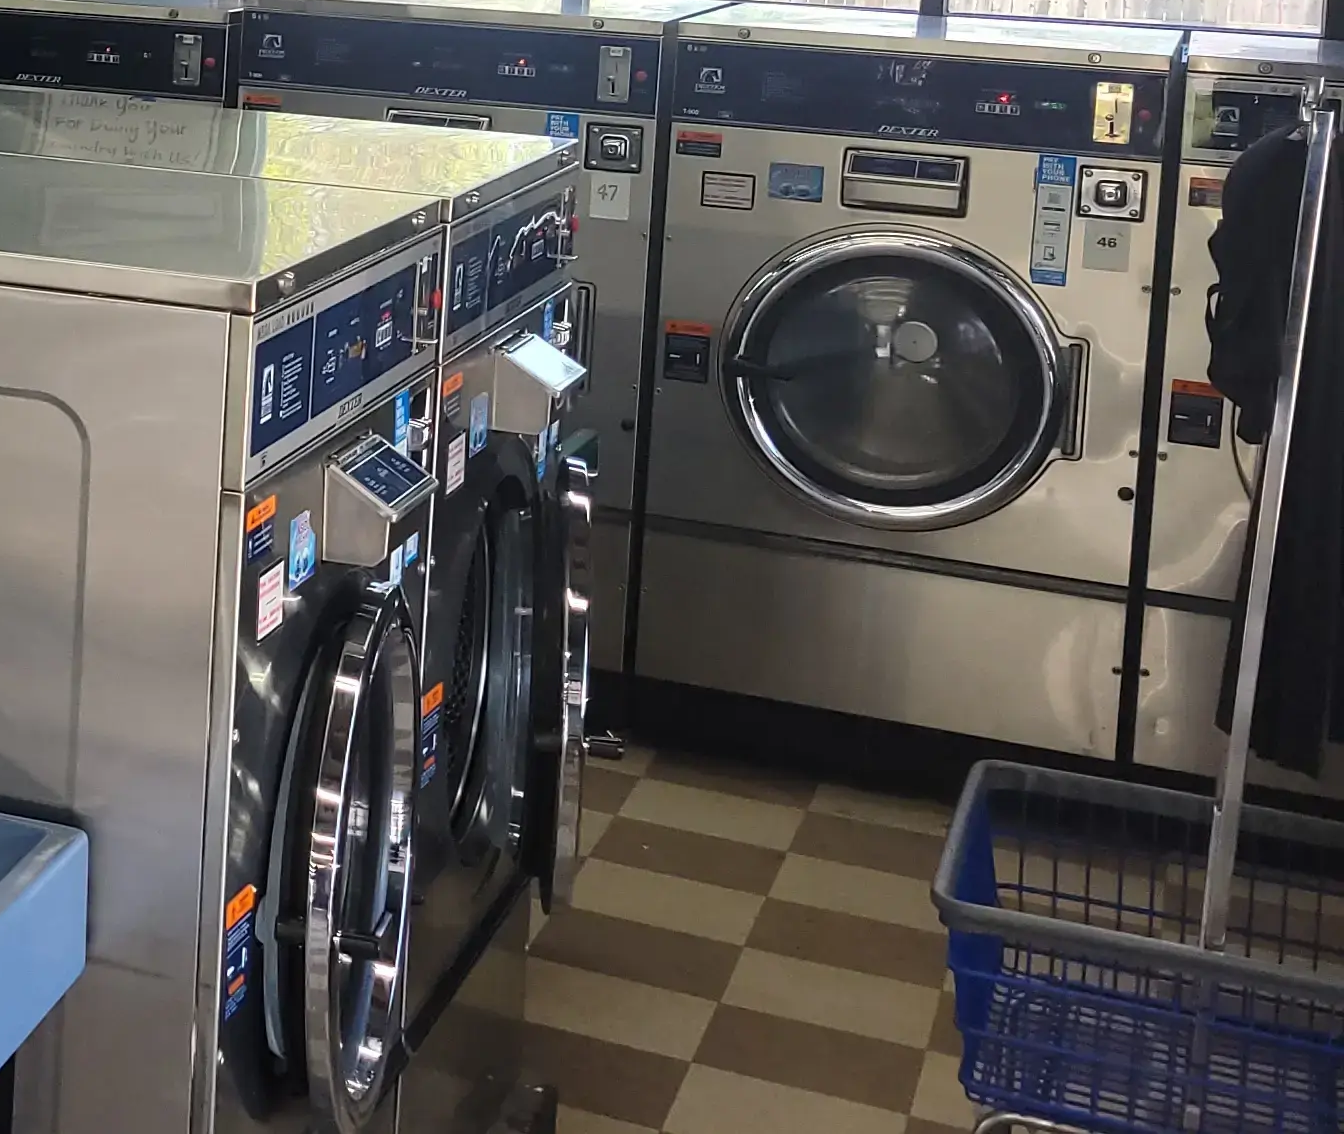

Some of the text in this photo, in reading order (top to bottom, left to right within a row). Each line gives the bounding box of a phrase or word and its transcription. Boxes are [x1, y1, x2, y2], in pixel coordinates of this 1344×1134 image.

[16, 73, 62, 84] DEXTER
[415, 87, 467, 98] DEXTER
[878, 125, 939, 137] DEXTER
[1042, 174, 1070, 183] PHONE
[597, 185, 617, 201] 47
[1096, 237, 1117, 248] 46
